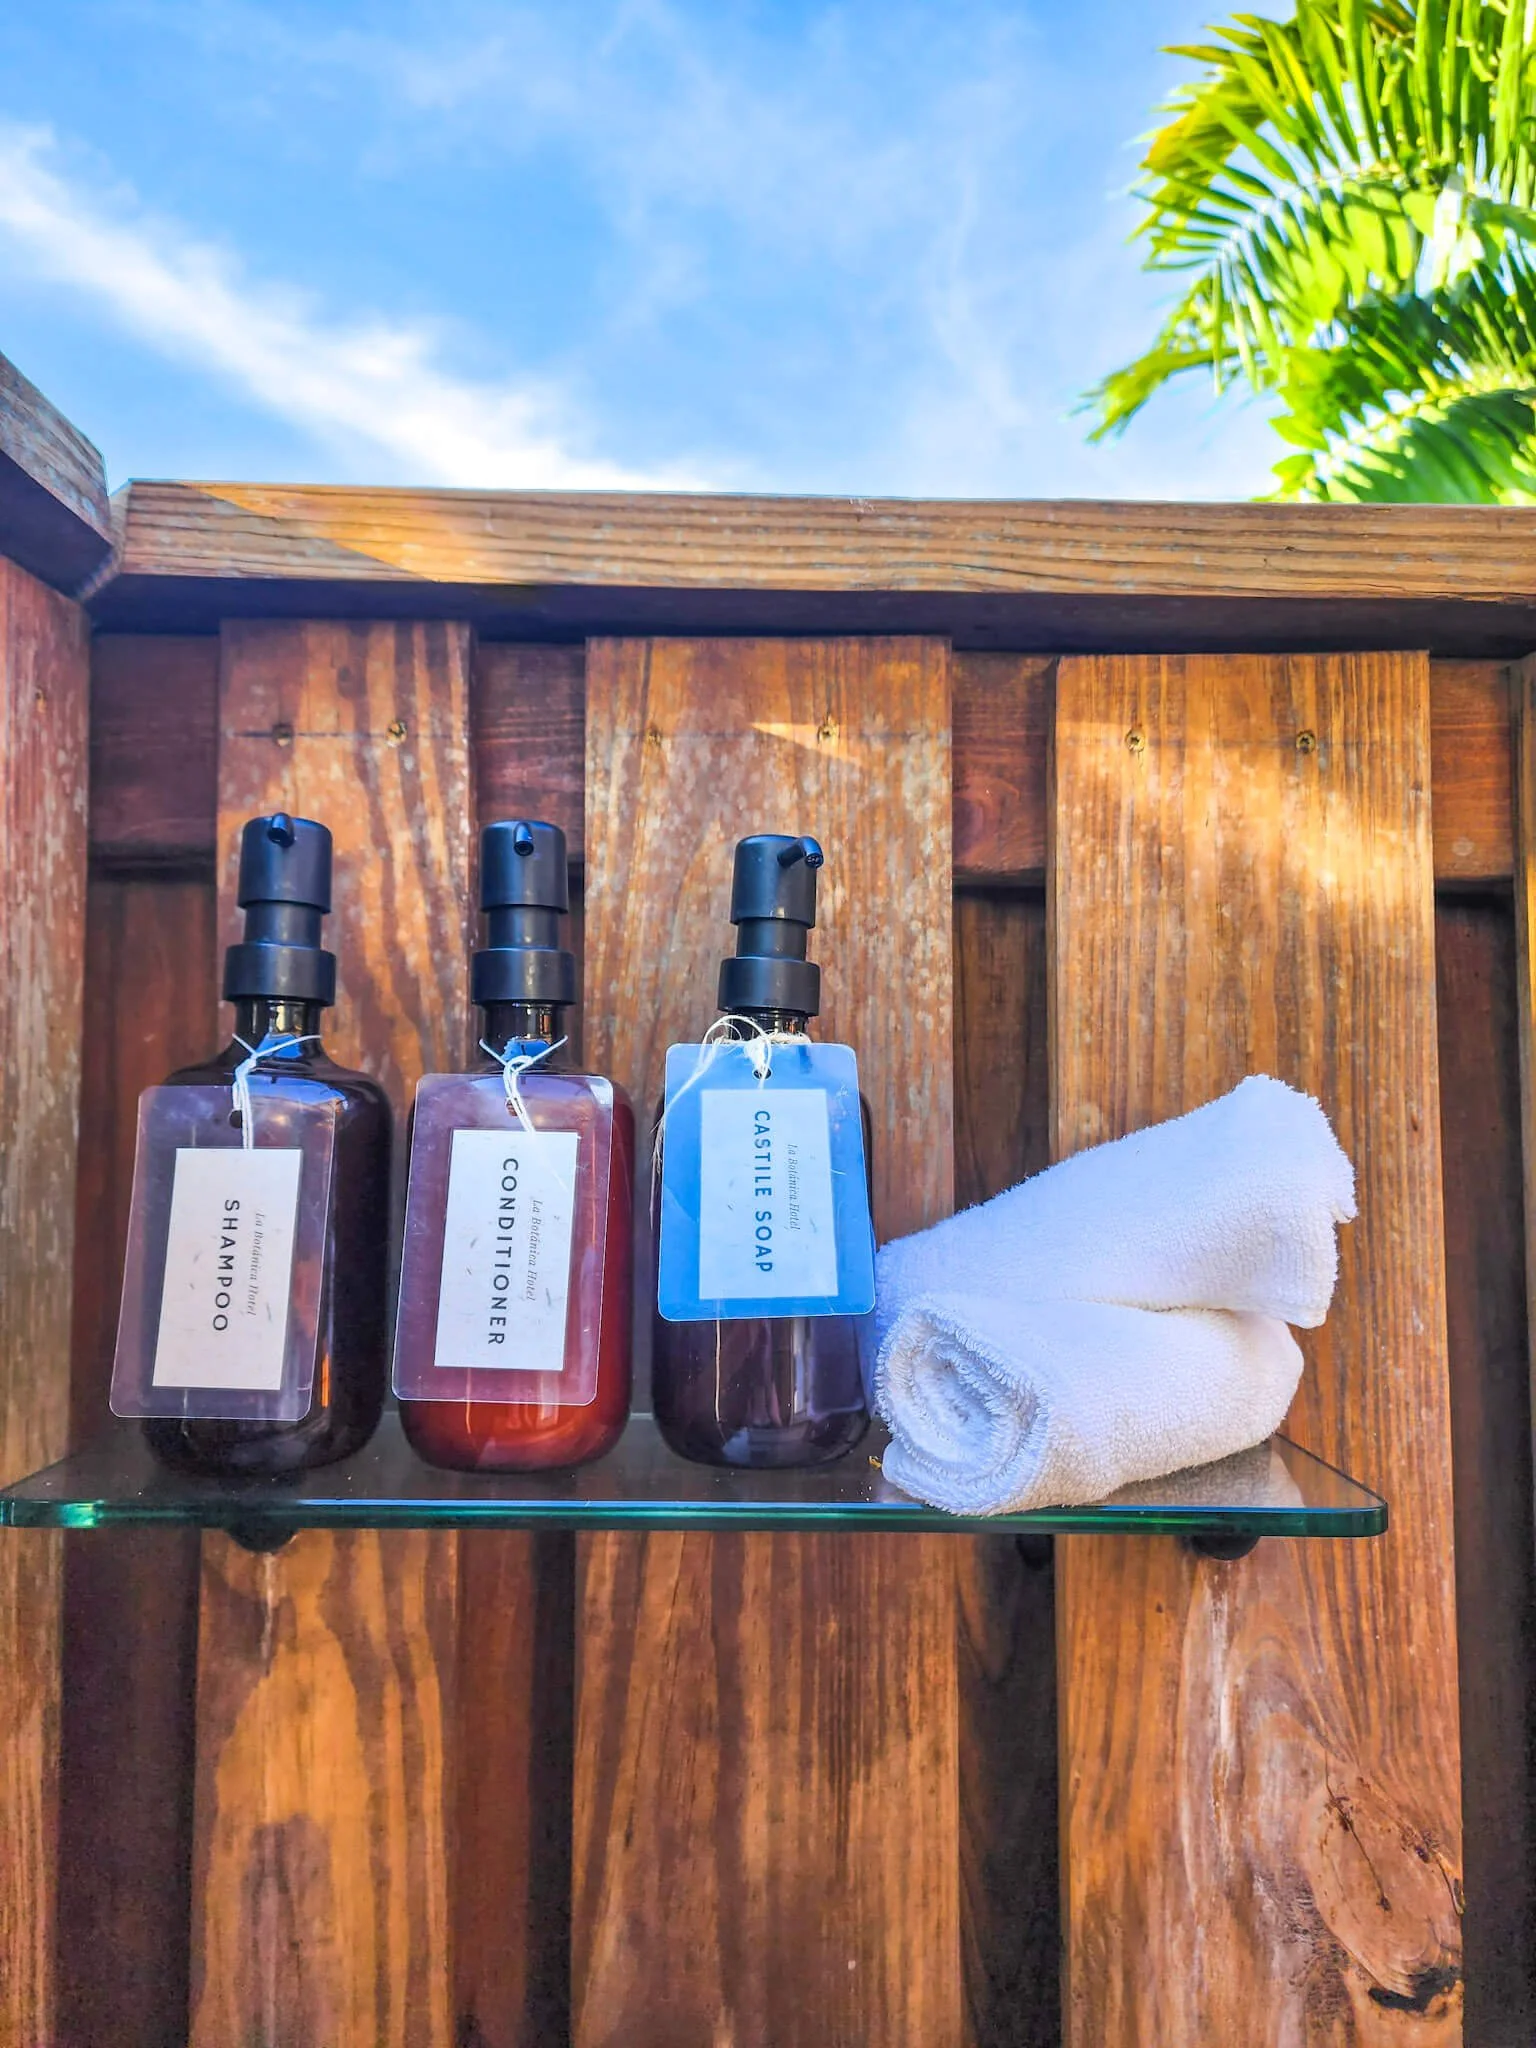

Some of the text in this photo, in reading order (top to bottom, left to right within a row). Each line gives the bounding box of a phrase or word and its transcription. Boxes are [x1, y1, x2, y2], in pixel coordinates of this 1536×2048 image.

[787, 1143, 798, 1155] La
[254, 1212, 265, 1227] La
[754, 1110, 773, 1272] CASTILE SOAP
[789, 1201, 801, 1230] Hotel
[212, 1199, 240, 1331] SHAMPOO
[487, 1158, 519, 1345] CONDITIONER
[526, 1199, 543, 1301] La Botánica Hotel
[247, 1285, 259, 1316] Hotel
